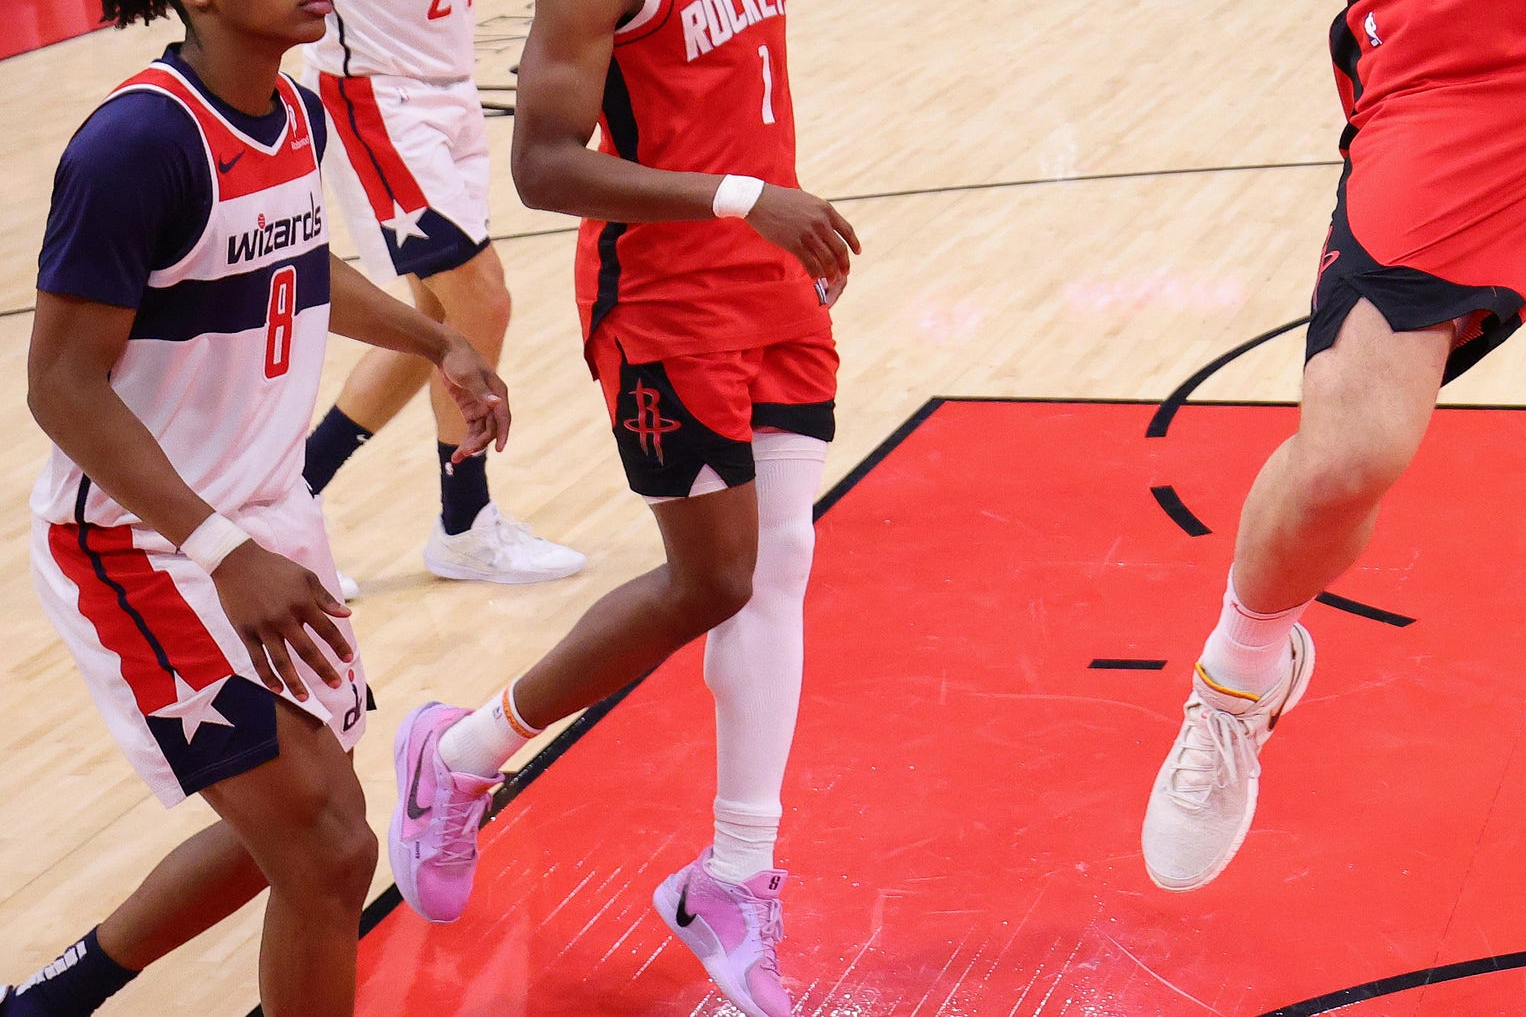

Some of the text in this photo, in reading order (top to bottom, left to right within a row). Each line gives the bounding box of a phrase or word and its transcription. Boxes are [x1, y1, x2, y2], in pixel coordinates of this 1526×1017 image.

[758, 44, 776, 124] 1
[226, 191, 322, 265] wizards
[264, 268, 296, 380] 8
